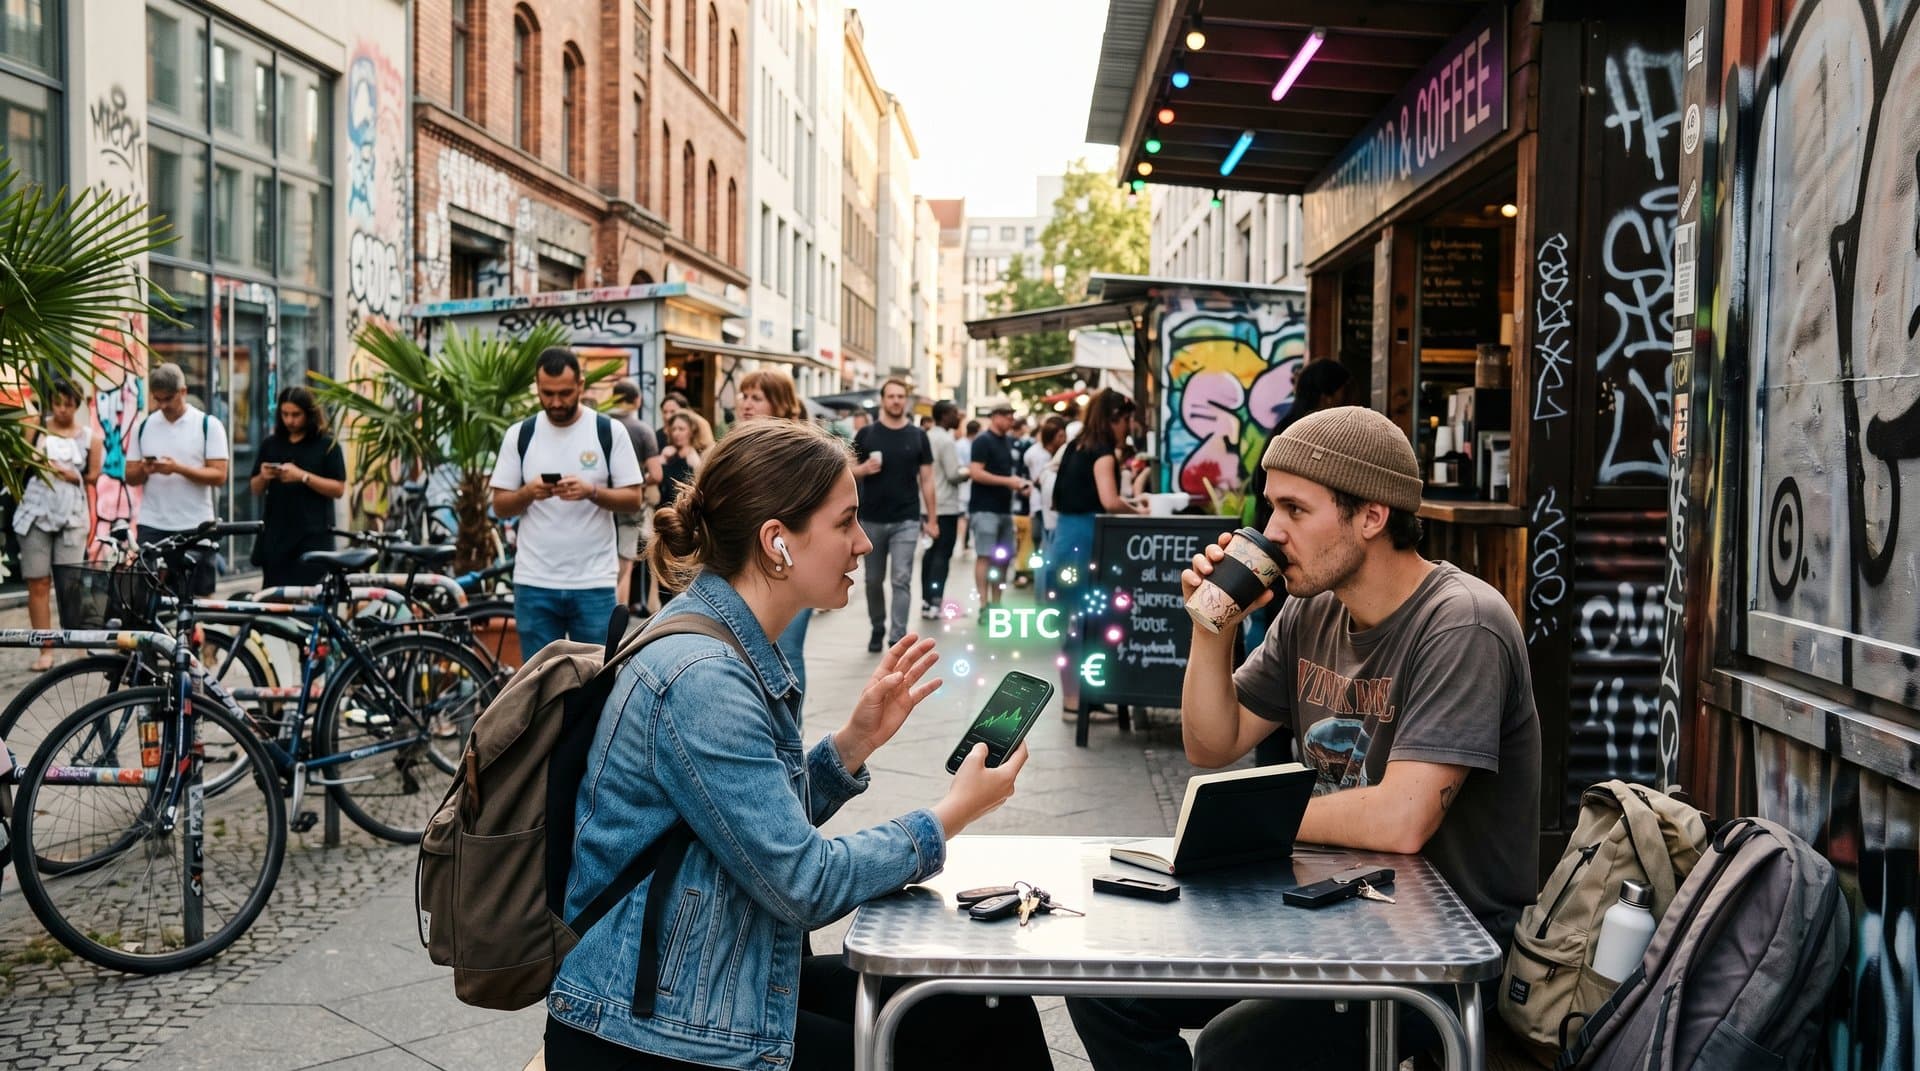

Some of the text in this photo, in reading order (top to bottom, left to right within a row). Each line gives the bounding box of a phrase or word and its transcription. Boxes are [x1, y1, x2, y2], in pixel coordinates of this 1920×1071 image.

[1401, 105, 1411, 180] &
[1416, 28, 1490, 168] COFFEE
[1127, 534, 1199, 562] COFFEE
